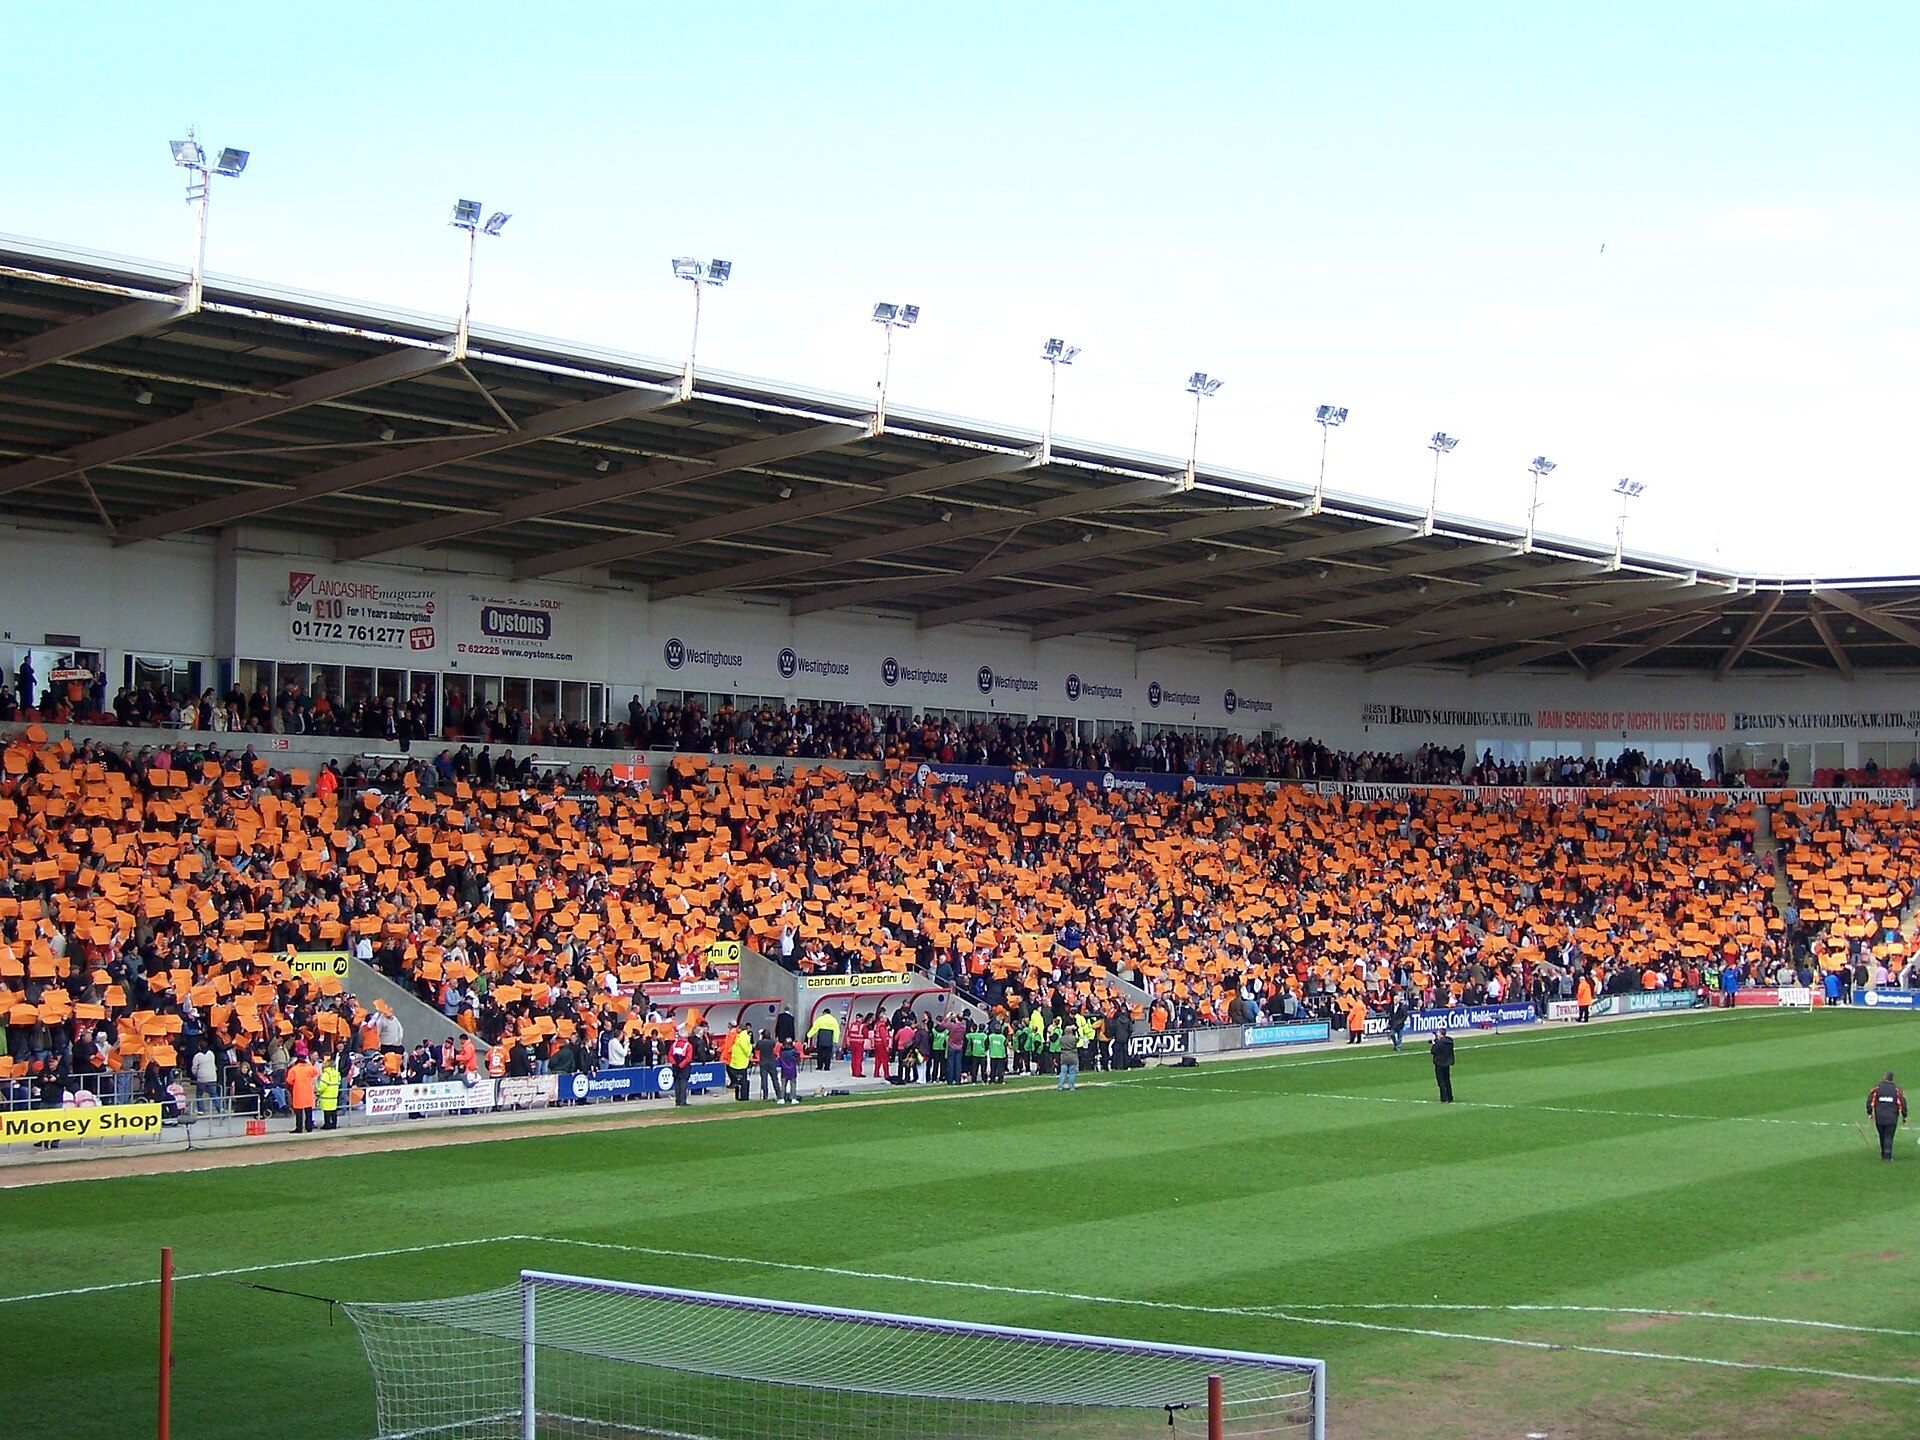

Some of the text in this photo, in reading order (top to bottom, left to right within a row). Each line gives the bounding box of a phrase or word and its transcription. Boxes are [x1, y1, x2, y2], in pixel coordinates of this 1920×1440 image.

[311, 580, 379, 600] LANCASHIRE
[379, 588, 436, 601] magazine
[297, 600, 431, 623] Only £10 For 1 Years subscription
[489, 610, 544, 634] Oystons
[293, 620, 405, 643] 01772 761277
[412, 636, 433, 648] TV
[469, 645, 572, 660] 622225 www.oystons.com
[687, 648, 742, 668] Westinghouse
[798, 658, 849, 676] Westinghouse
[900, 667, 947, 684] Westinghouse
[994, 675, 1038, 691] Westinghouse
[1082, 683, 1122, 699] Westinghouse
[1163, 690, 1200, 706] Westinghouse
[1238, 697, 1272, 712] Westinghouse
[1537, 710, 1726, 731] MAIN SPONSOR OF NORTH WEST STAND
[1479, 787, 1499, 805] MAIN
[1877, 789, 1909, 799] 01253
[292, 962, 326, 971] brini
[808, 977, 845, 986] carbrini
[861, 975, 897, 984] carbrini
[1412, 1013, 1447, 1031] Thomas
[1448, 1009, 1470, 1028] Cook
[589, 1077, 631, 1091] Westinghouse
[368, 1088, 401, 1098] CLIFTON
[371, 1104, 397, 1113] MEATS
[417, 1102, 438, 1110] 01253
[440, 1100, 465, 1108] 697070
[6, 1113, 158, 1135] Money Shop
